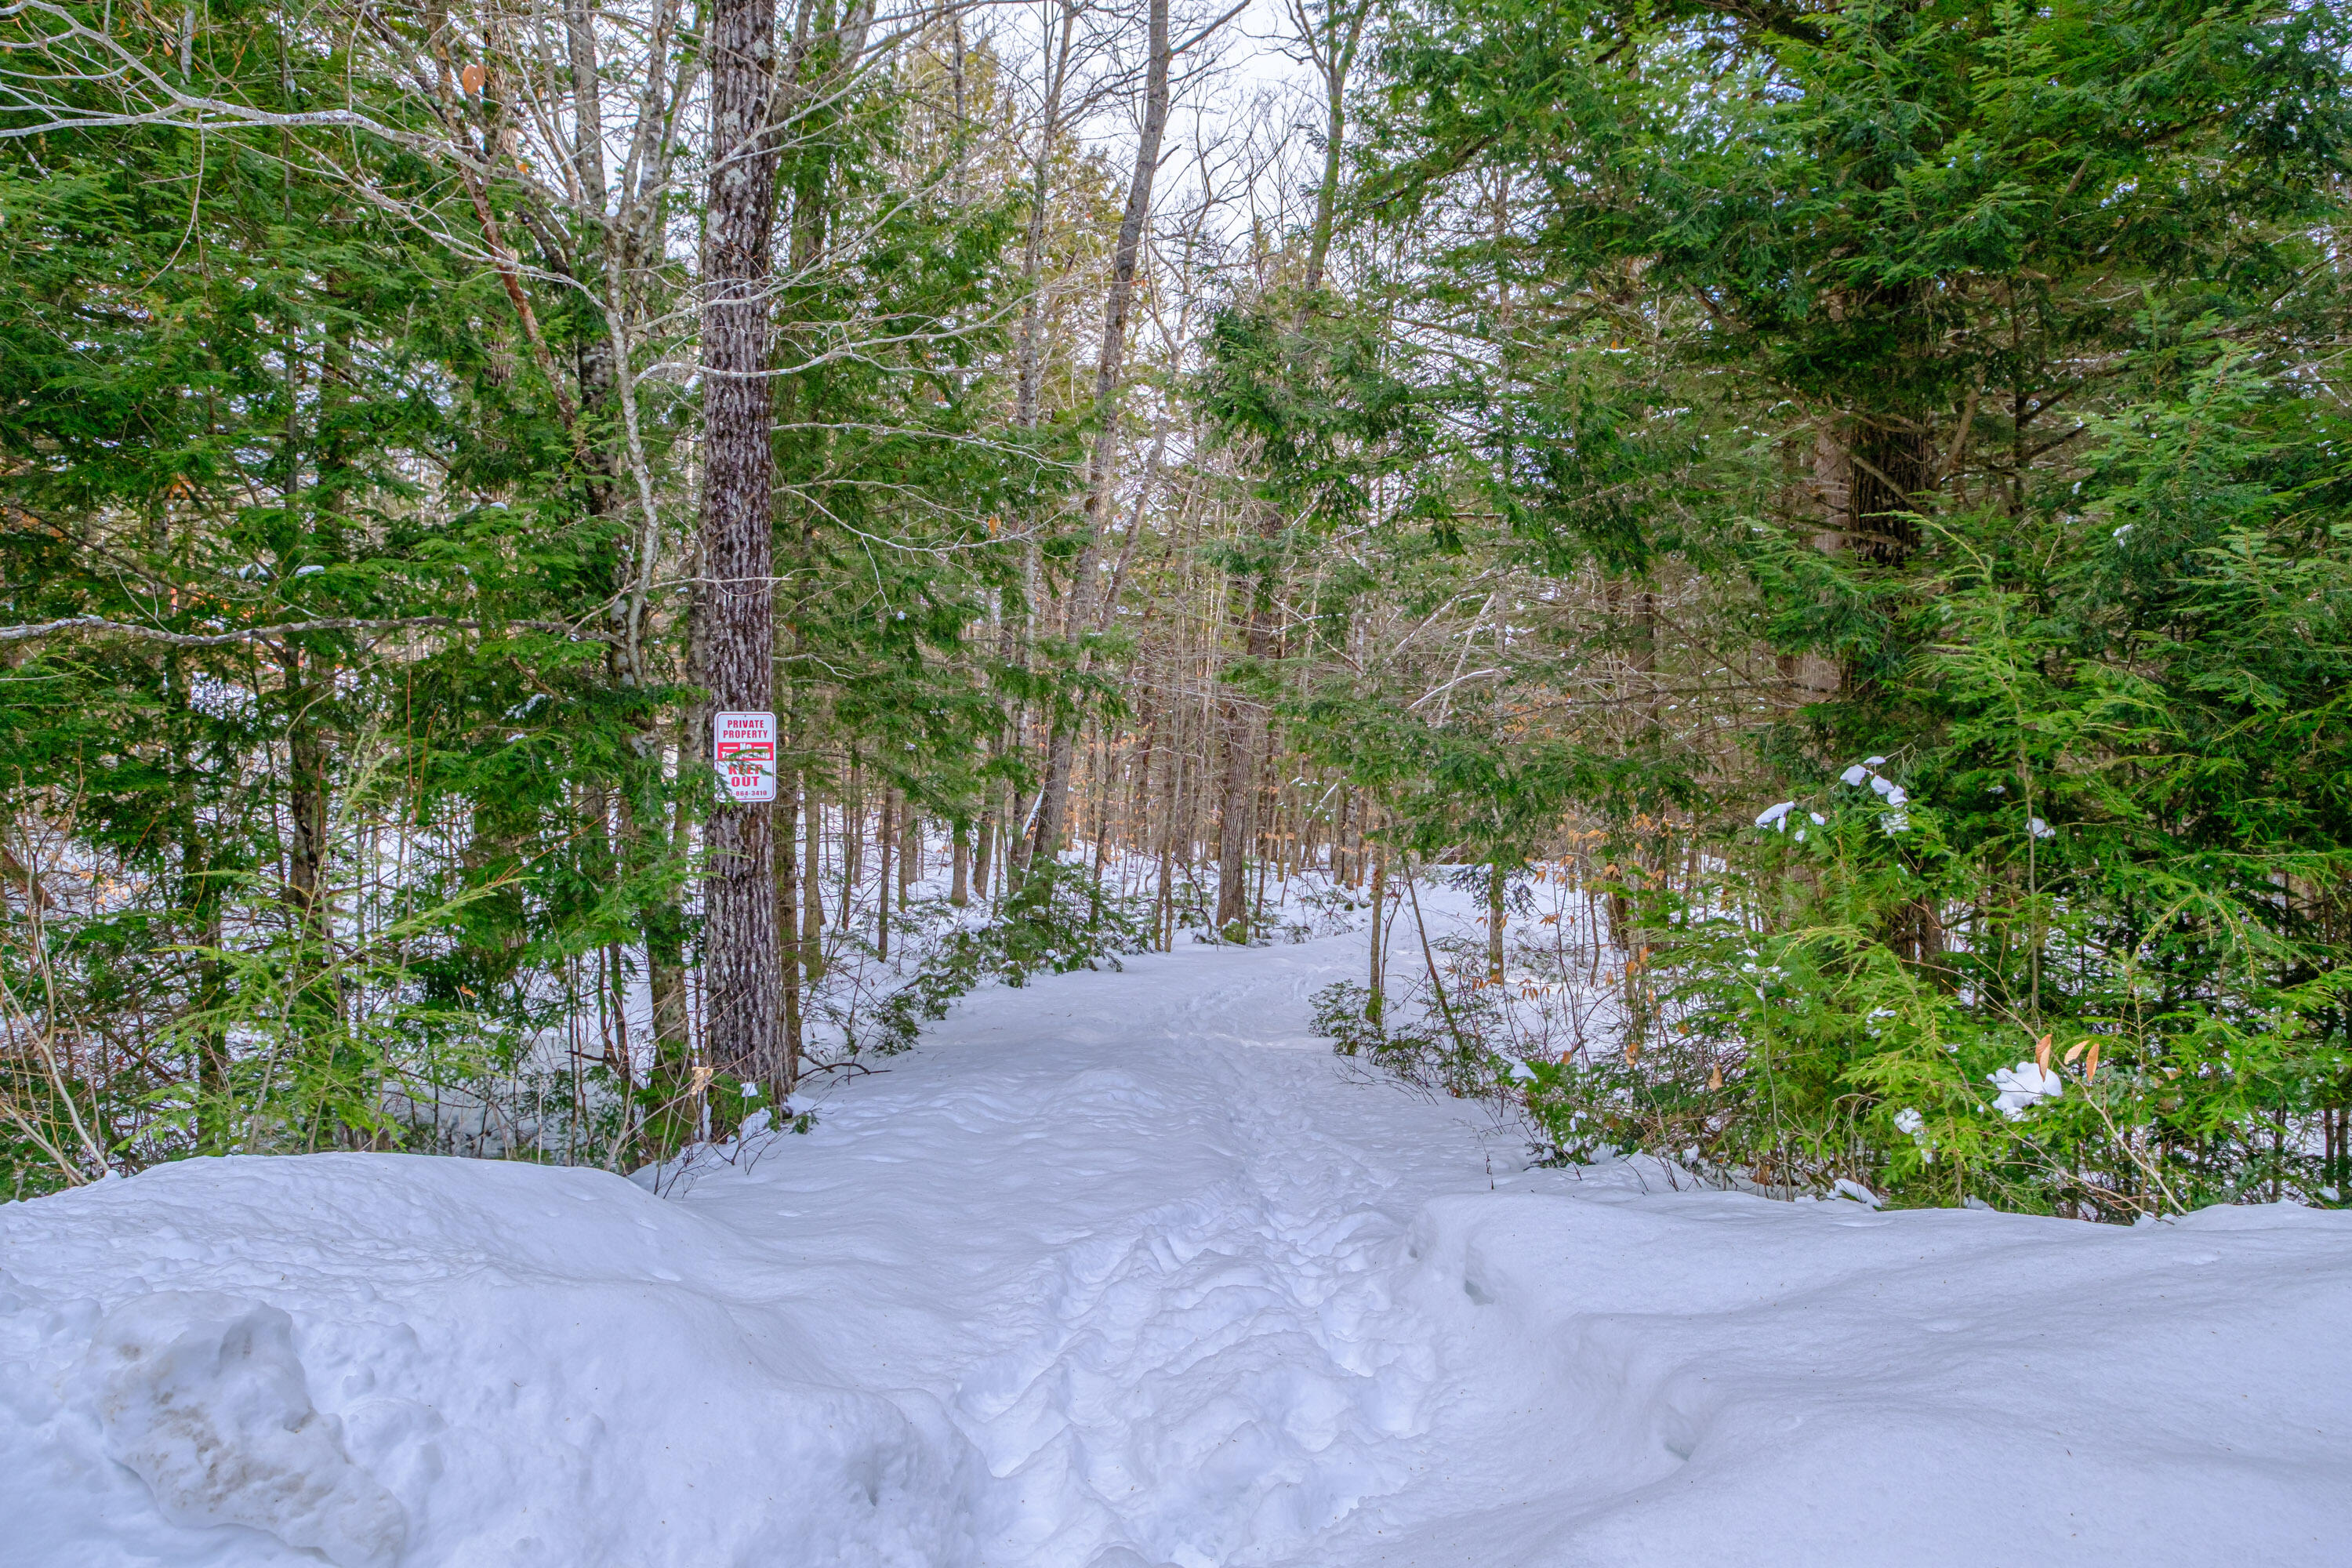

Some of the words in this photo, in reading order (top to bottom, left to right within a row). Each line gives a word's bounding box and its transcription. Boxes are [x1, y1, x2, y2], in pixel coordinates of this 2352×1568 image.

[728, 720, 764, 728] PRIVATE
[723, 730, 768, 739] PROPERTY
[728, 764, 763, 775] KEEP
[731, 776, 760, 787] OUT
